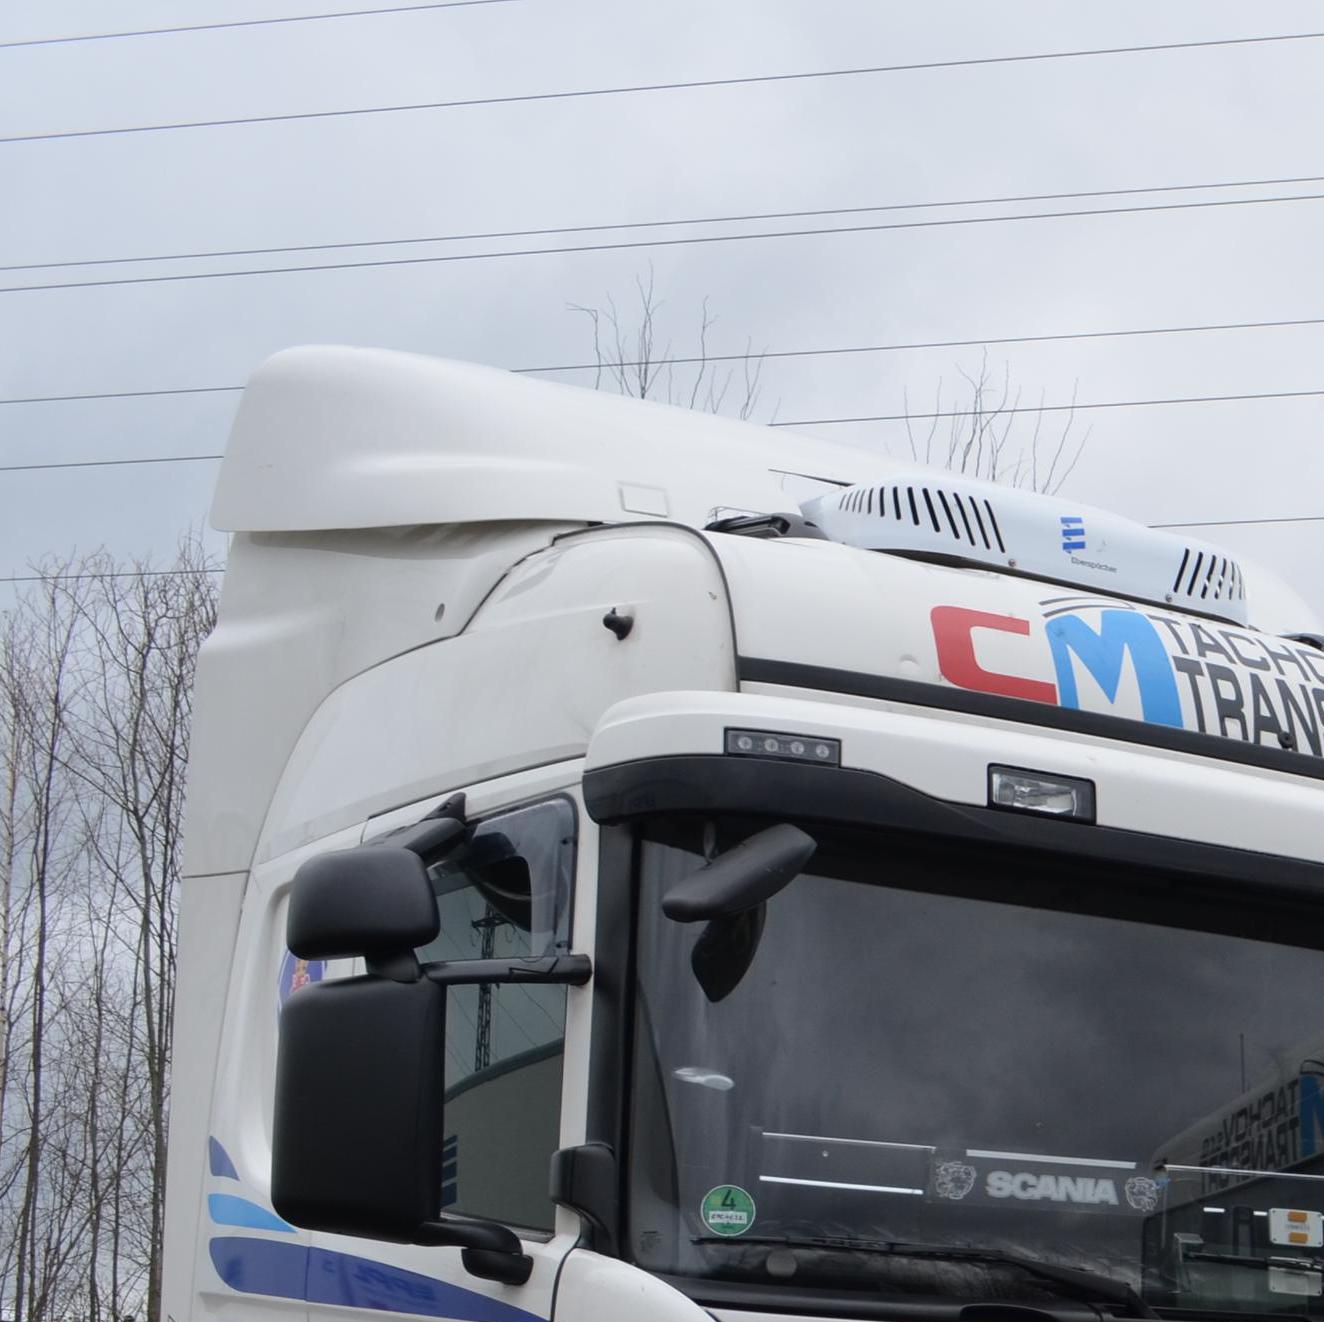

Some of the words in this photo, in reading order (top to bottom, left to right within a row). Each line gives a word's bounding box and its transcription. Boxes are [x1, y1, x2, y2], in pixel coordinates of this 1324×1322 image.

[931, 605, 1184, 729] CM
[721, 1189, 736, 1211] 4
[985, 1169, 1119, 1205] SCANIA
